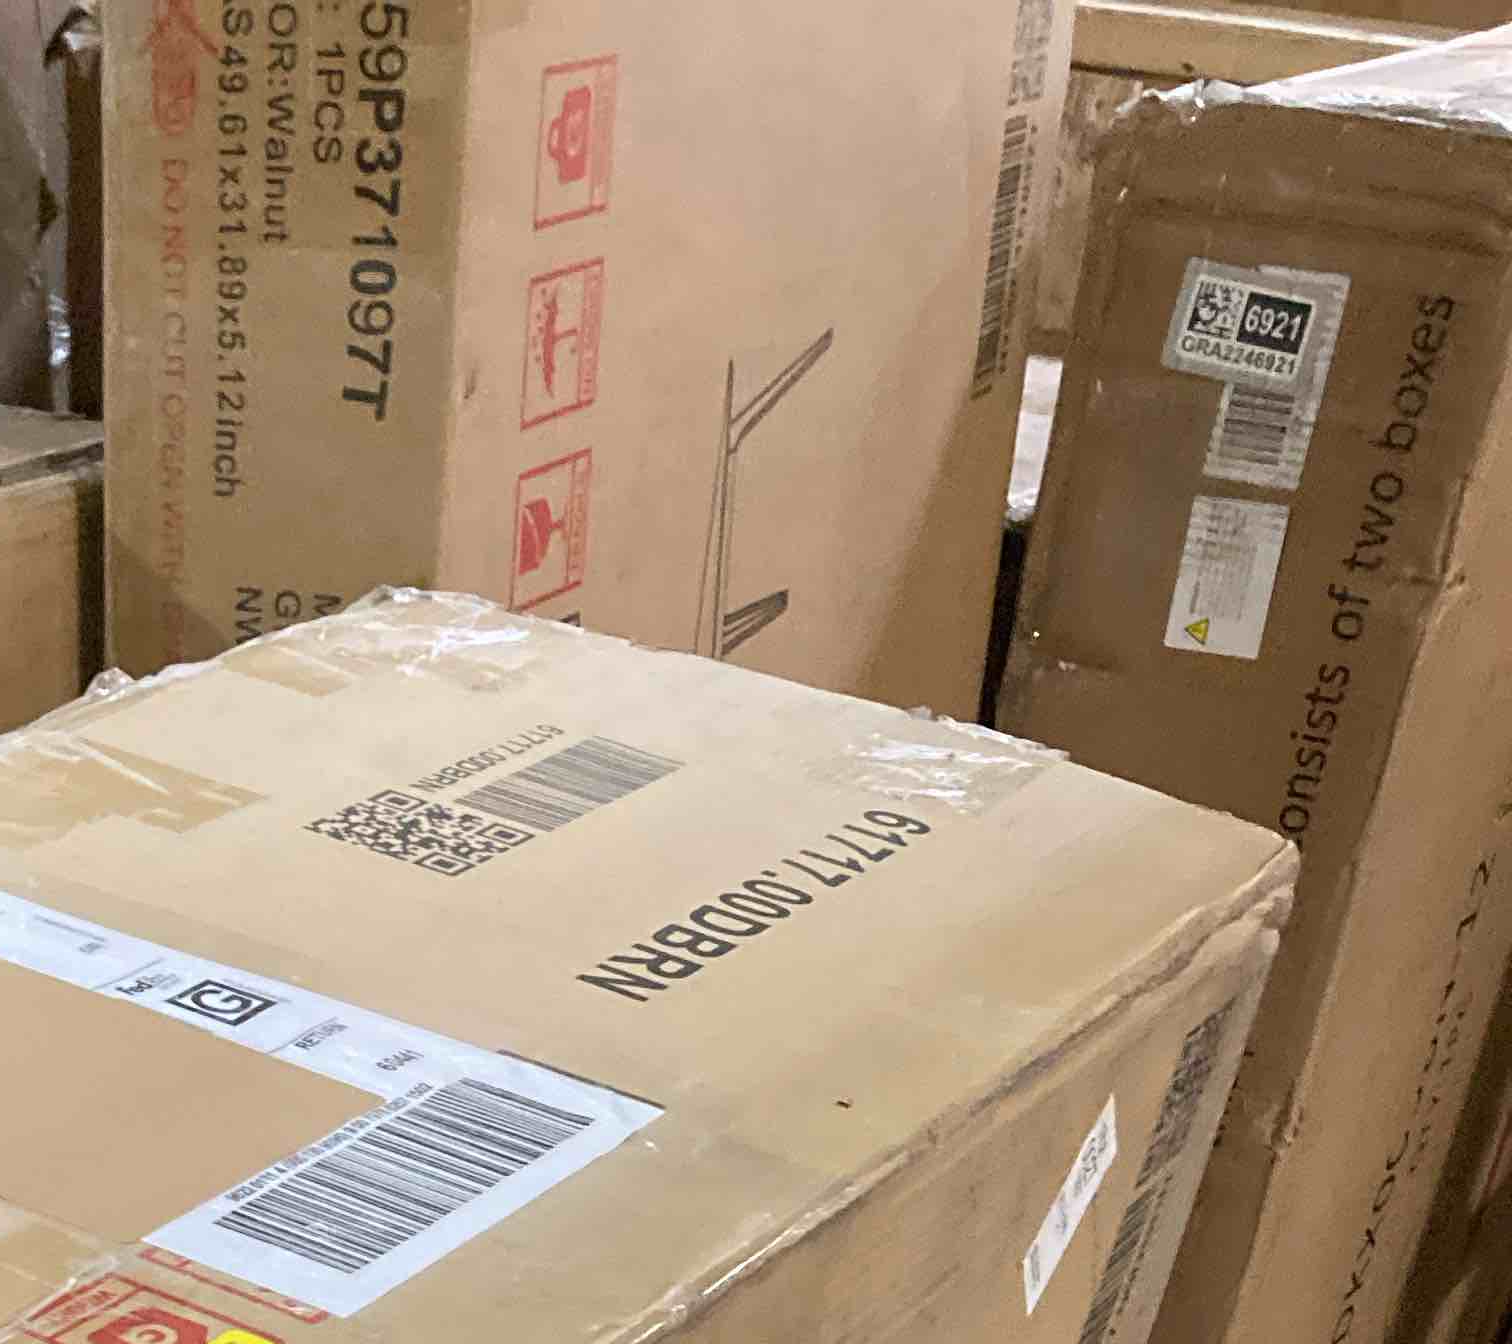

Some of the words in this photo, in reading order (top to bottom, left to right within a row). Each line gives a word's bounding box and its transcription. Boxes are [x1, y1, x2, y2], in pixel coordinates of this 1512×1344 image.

[1180, 335, 1296, 375] GRA2246921
[1244, 304, 1303, 342] 6921
[1328, 584, 1369, 641] of
[1349, 472, 1405, 574] two
[1377, 293, 1455, 453] boxes
[576, 809, 932, 1002] 61717.00DBRN
